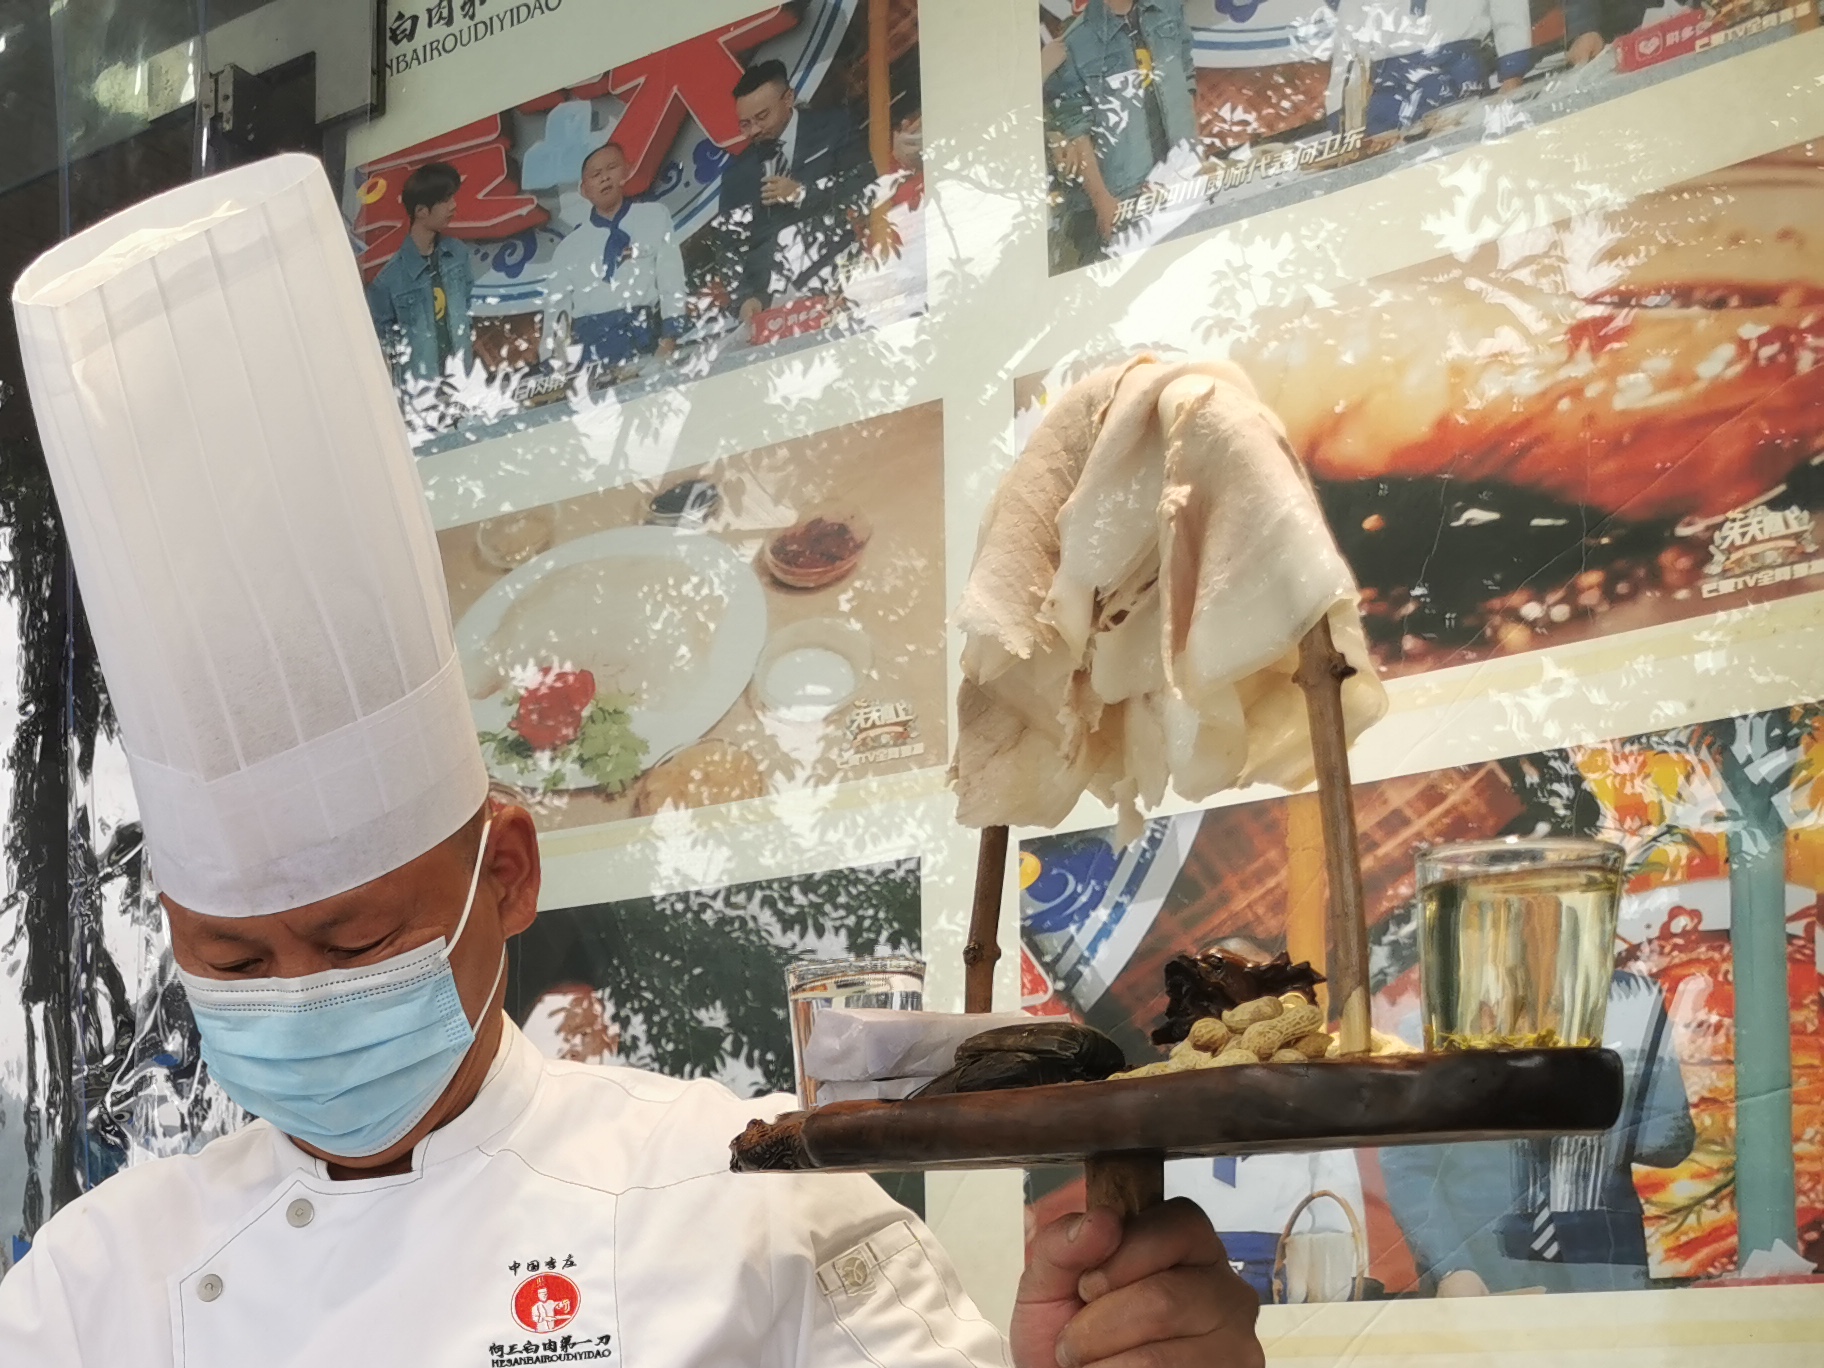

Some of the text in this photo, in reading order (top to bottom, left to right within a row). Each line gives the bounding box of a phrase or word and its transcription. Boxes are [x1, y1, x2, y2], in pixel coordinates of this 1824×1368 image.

[508, 1253, 577, 1277] 中国李庄
[488, 1334, 612, 1358] 何三白肉第一刀
[491, 1348, 612, 1368] HESANBAIROUDIYIDAO
